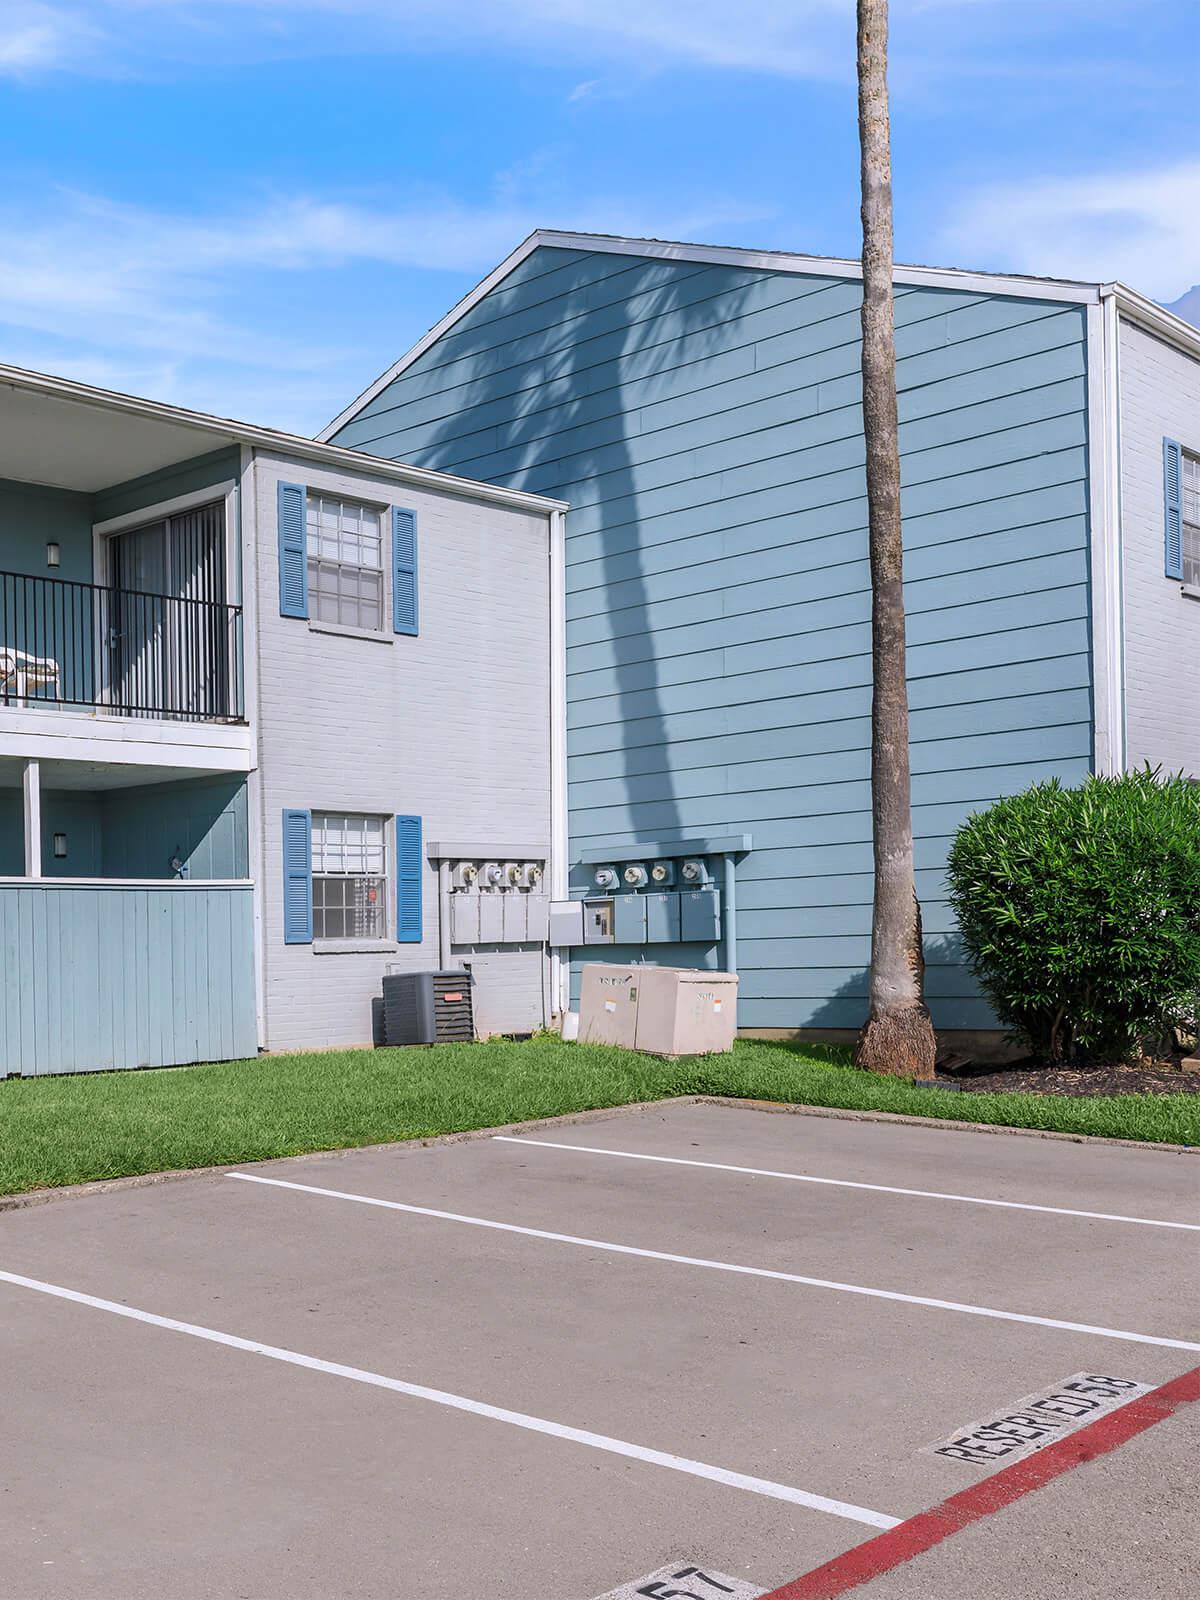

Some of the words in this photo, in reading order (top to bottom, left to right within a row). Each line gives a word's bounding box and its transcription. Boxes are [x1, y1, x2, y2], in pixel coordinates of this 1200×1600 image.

[934, 1394, 1100, 1466] RESERVED
[1063, 1375, 1139, 1399] 58
[636, 1566, 736, 1600] 57
